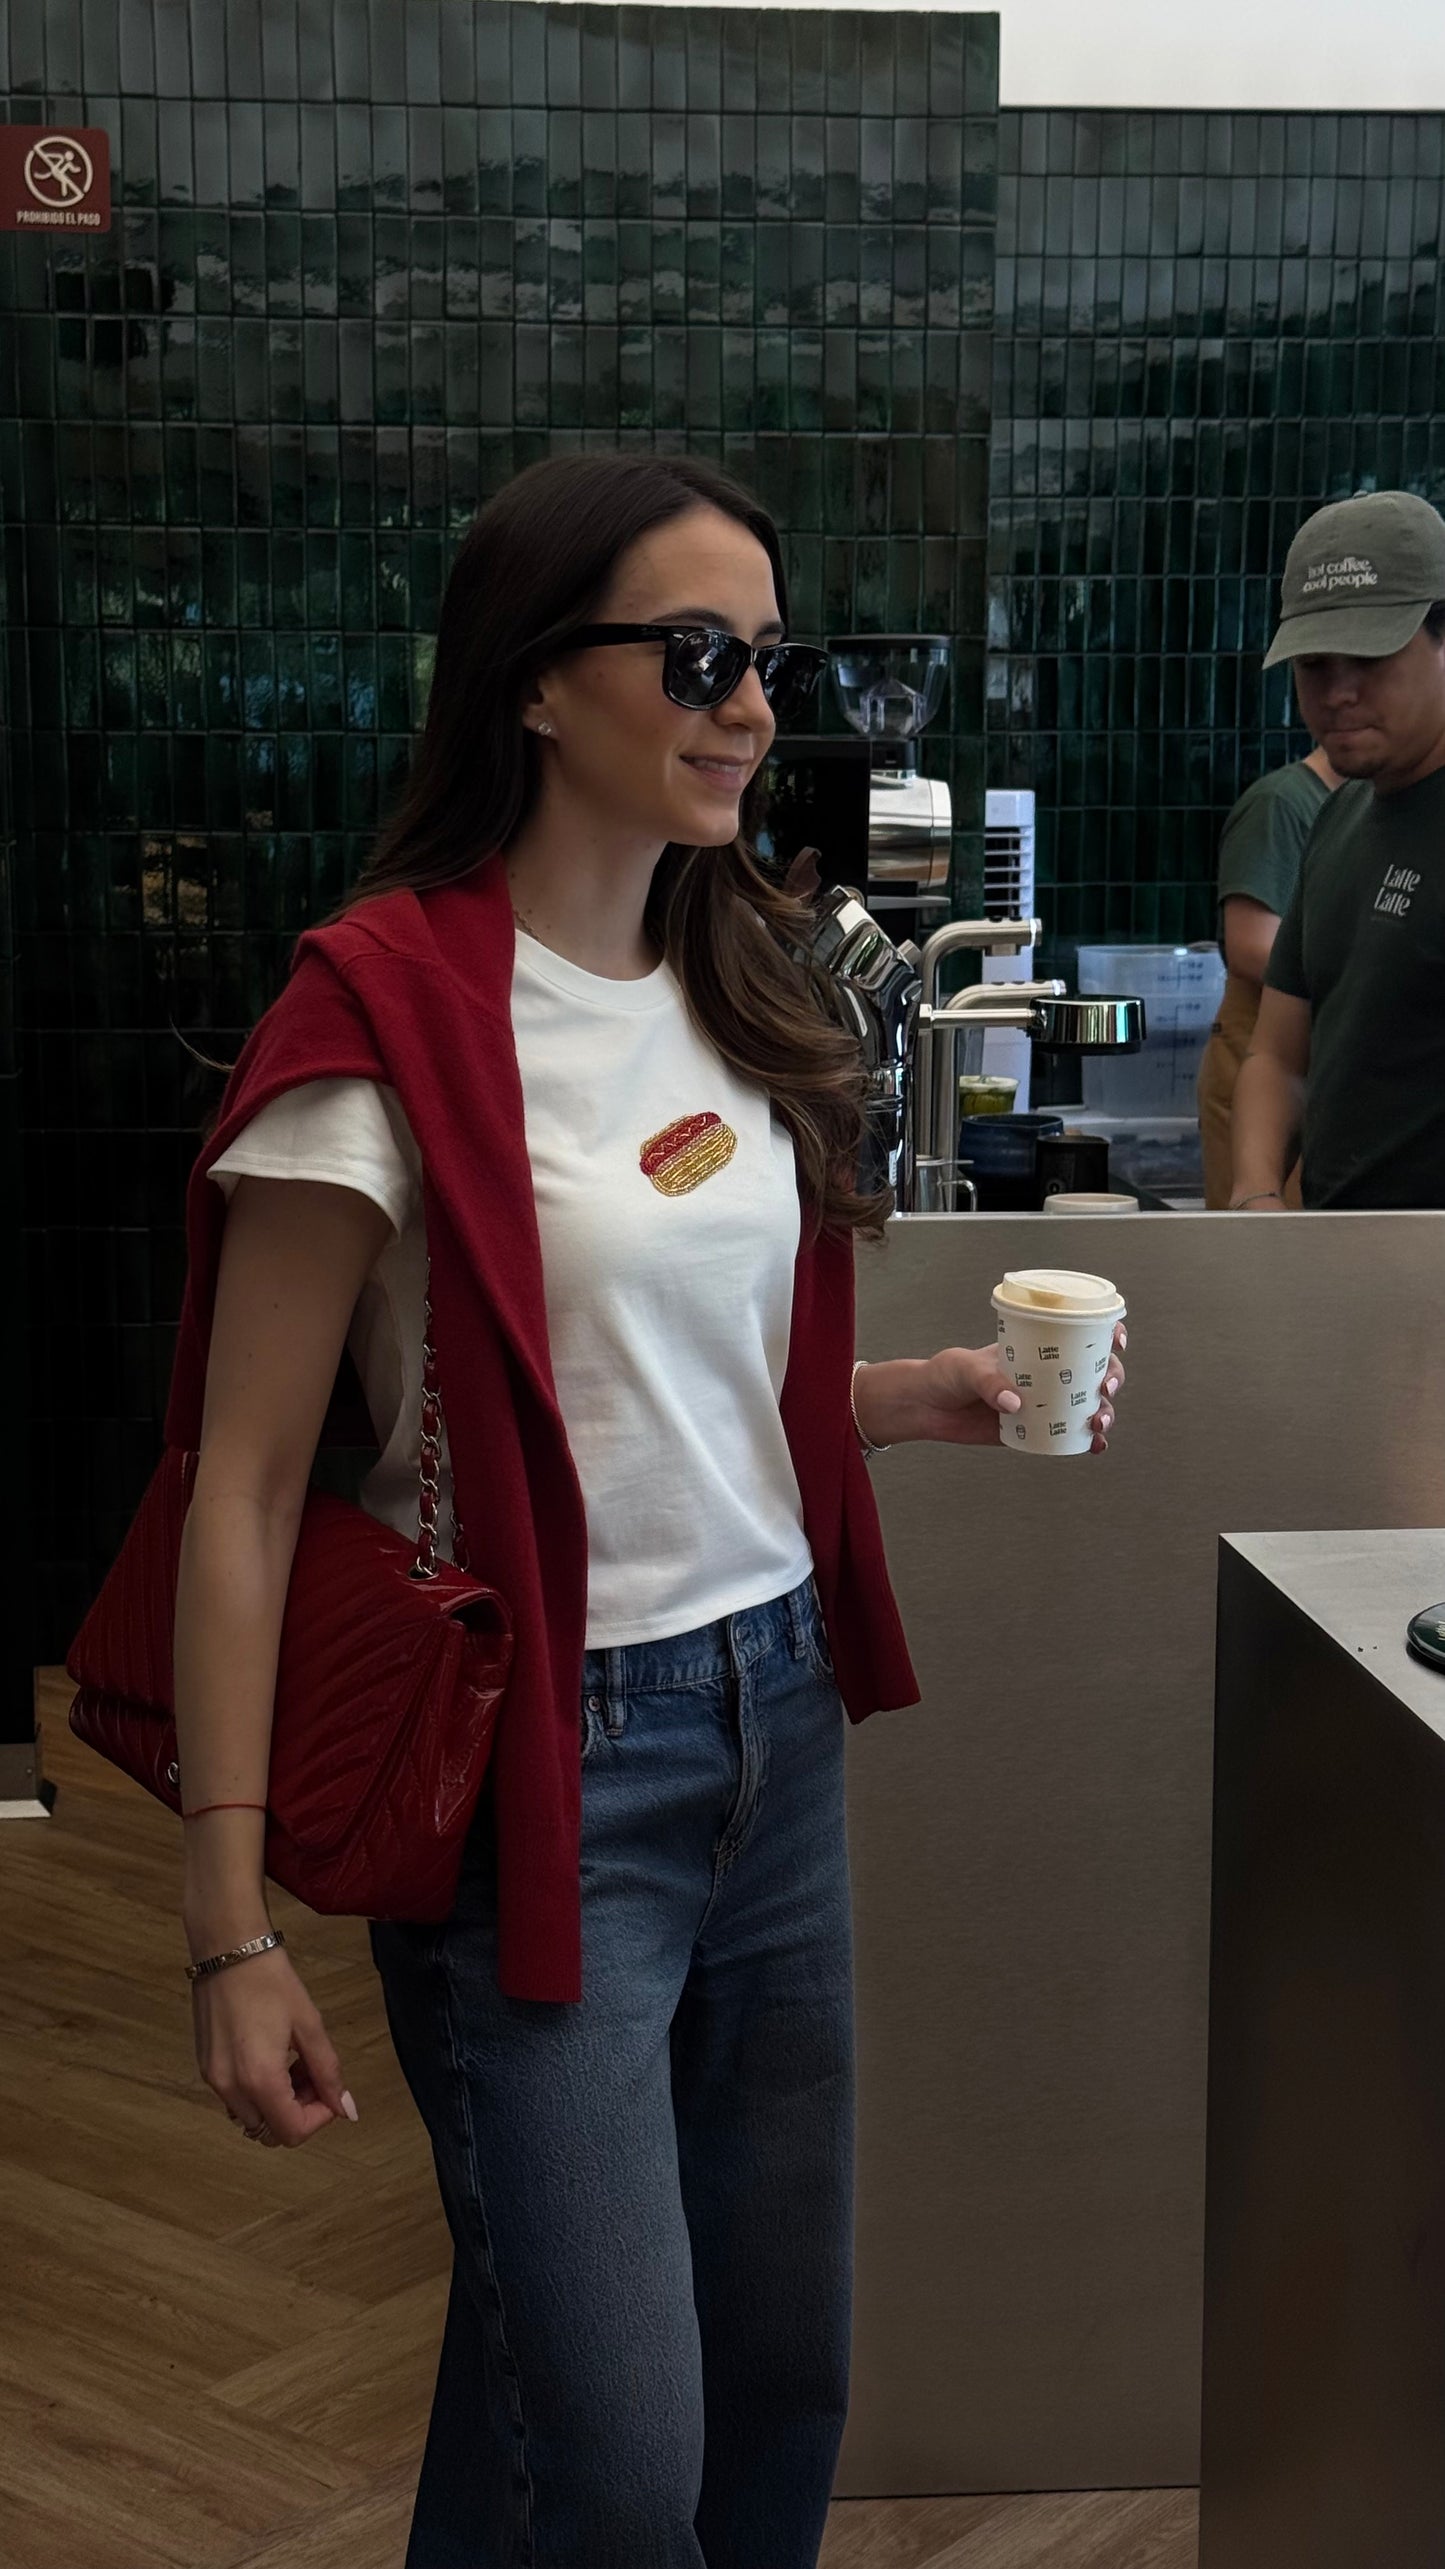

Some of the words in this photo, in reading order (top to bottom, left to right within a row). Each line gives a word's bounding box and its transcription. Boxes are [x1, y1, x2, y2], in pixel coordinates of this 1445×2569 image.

[16, 210, 65, 224] PROHIBIDO
[65, 212, 77, 225] EL
[77, 212, 101, 226] PASO
[1328, 571, 1378, 590] people
[1383, 864, 1421, 892] Latte
[1373, 886, 1411, 917] Latte
[1038, 1346, 1060, 1354] Latte
[1039, 1352, 1060, 1361] Latte
